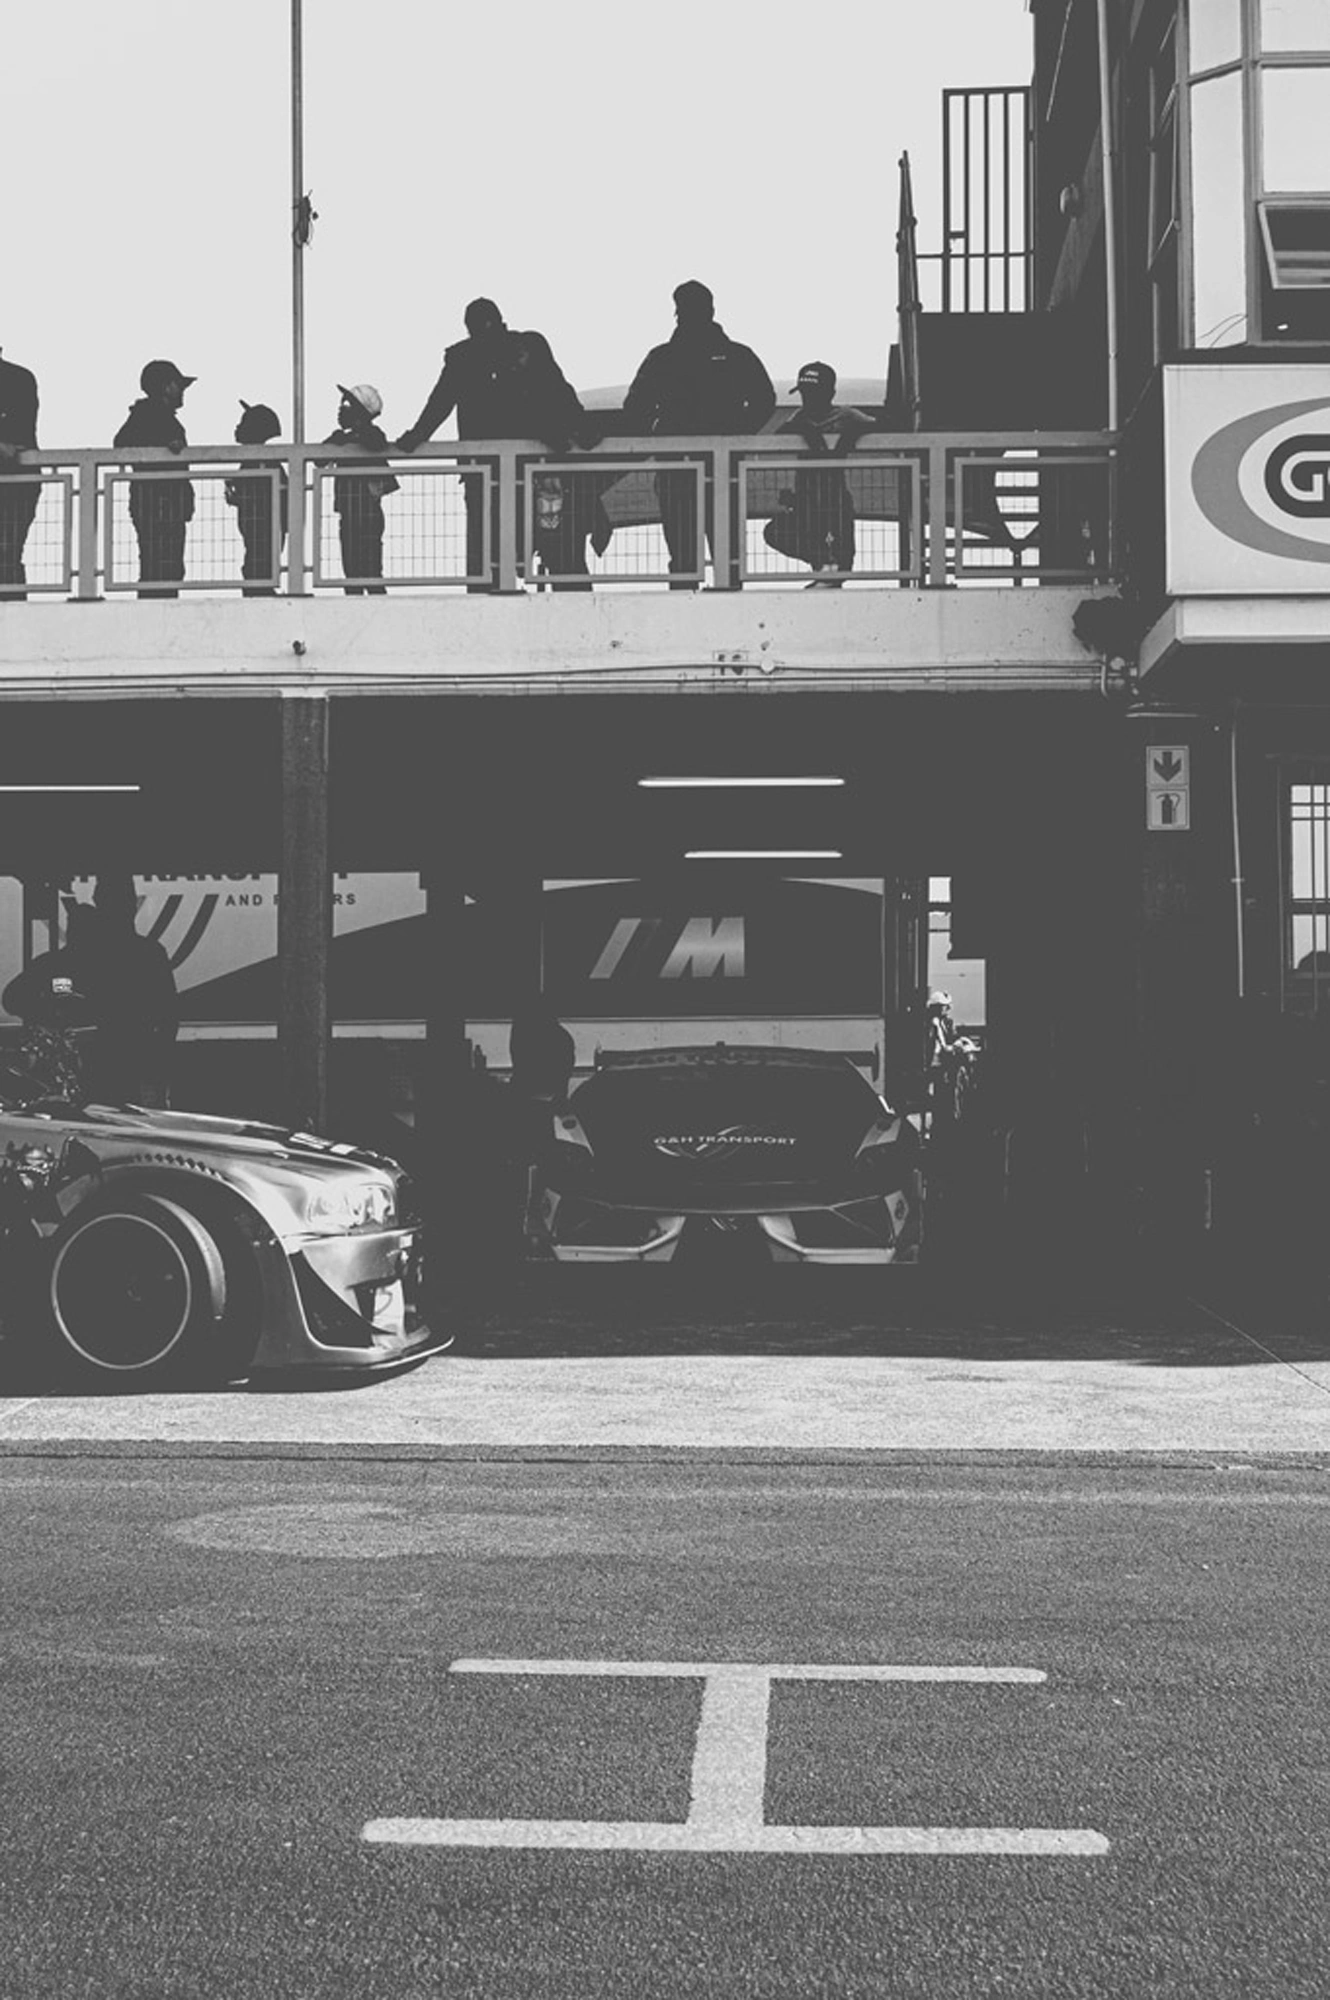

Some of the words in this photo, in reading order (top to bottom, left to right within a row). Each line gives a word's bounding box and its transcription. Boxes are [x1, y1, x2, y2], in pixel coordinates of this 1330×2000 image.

[1281, 450, 1330, 501] G
[225, 894, 263, 906] AND
[699, 1135, 796, 1145] TRANSPORT
